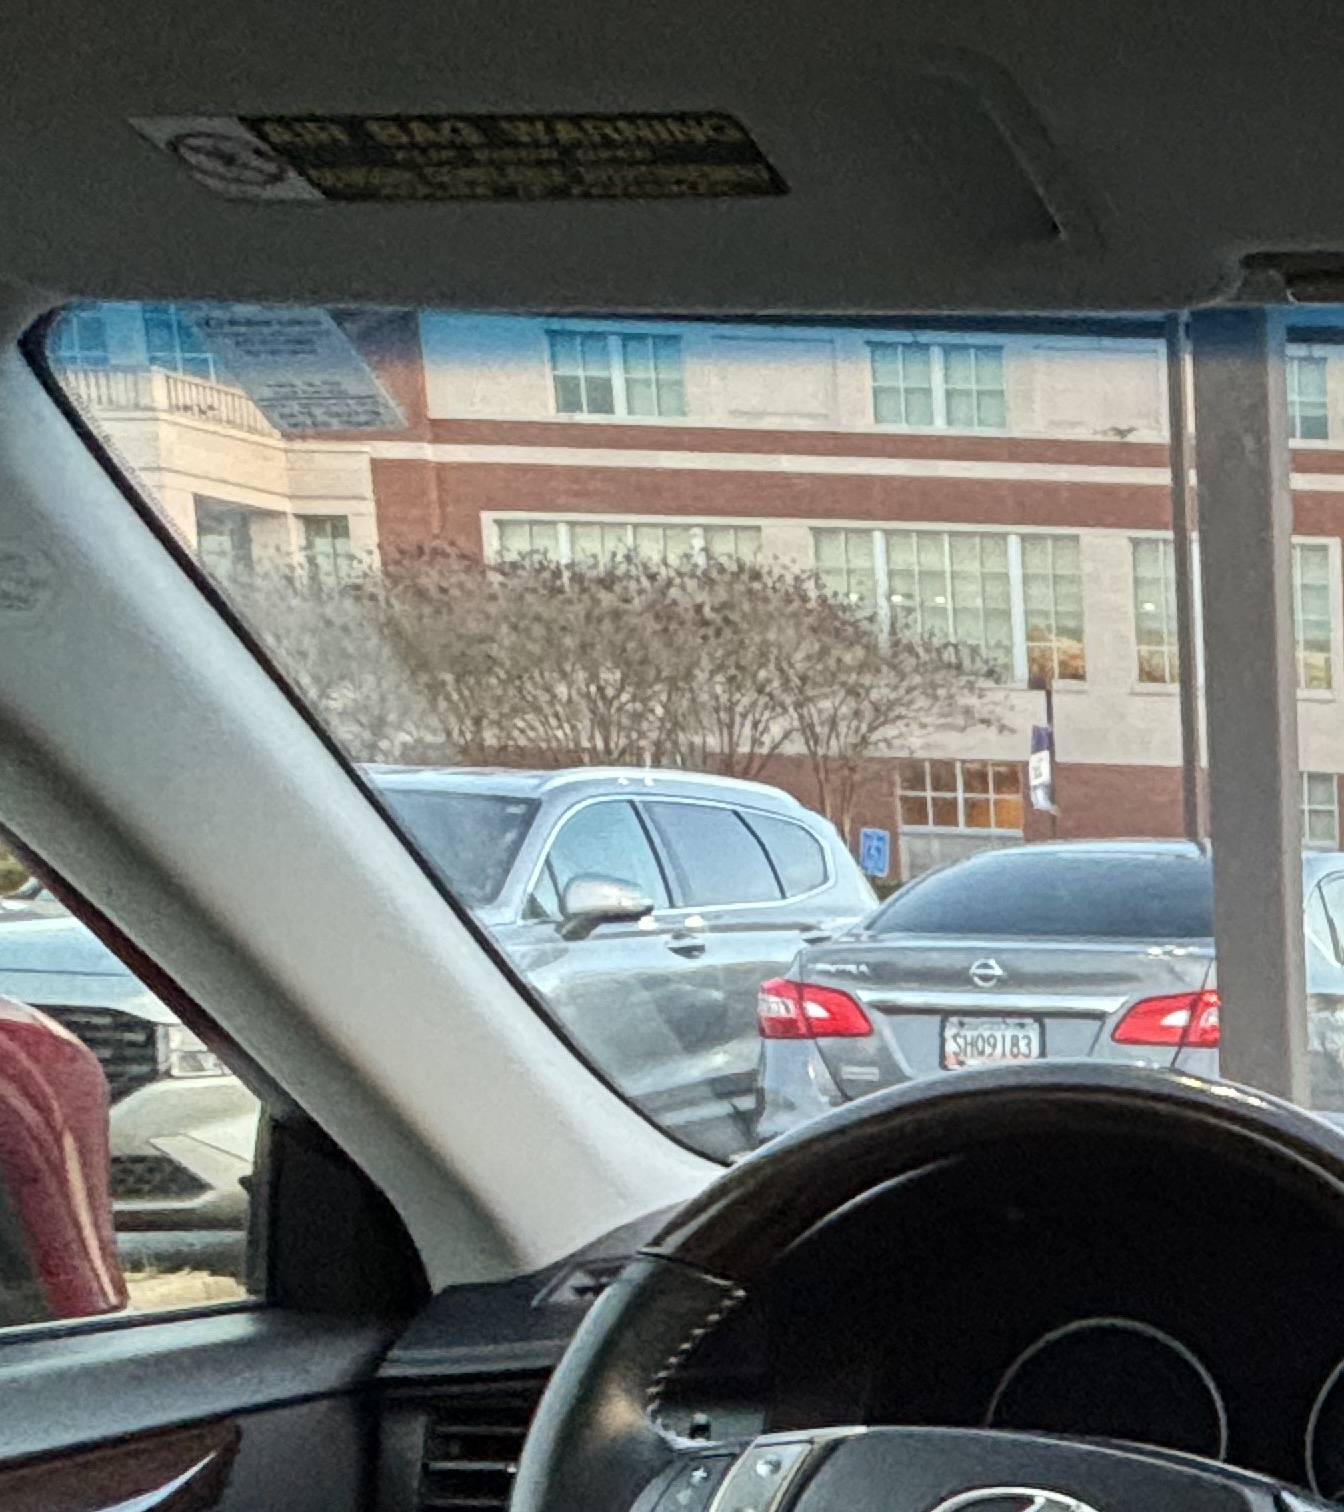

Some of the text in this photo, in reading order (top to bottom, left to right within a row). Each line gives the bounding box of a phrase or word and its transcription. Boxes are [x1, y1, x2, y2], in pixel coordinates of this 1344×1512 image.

[264, 117, 745, 145] AIR BAG WARNING
